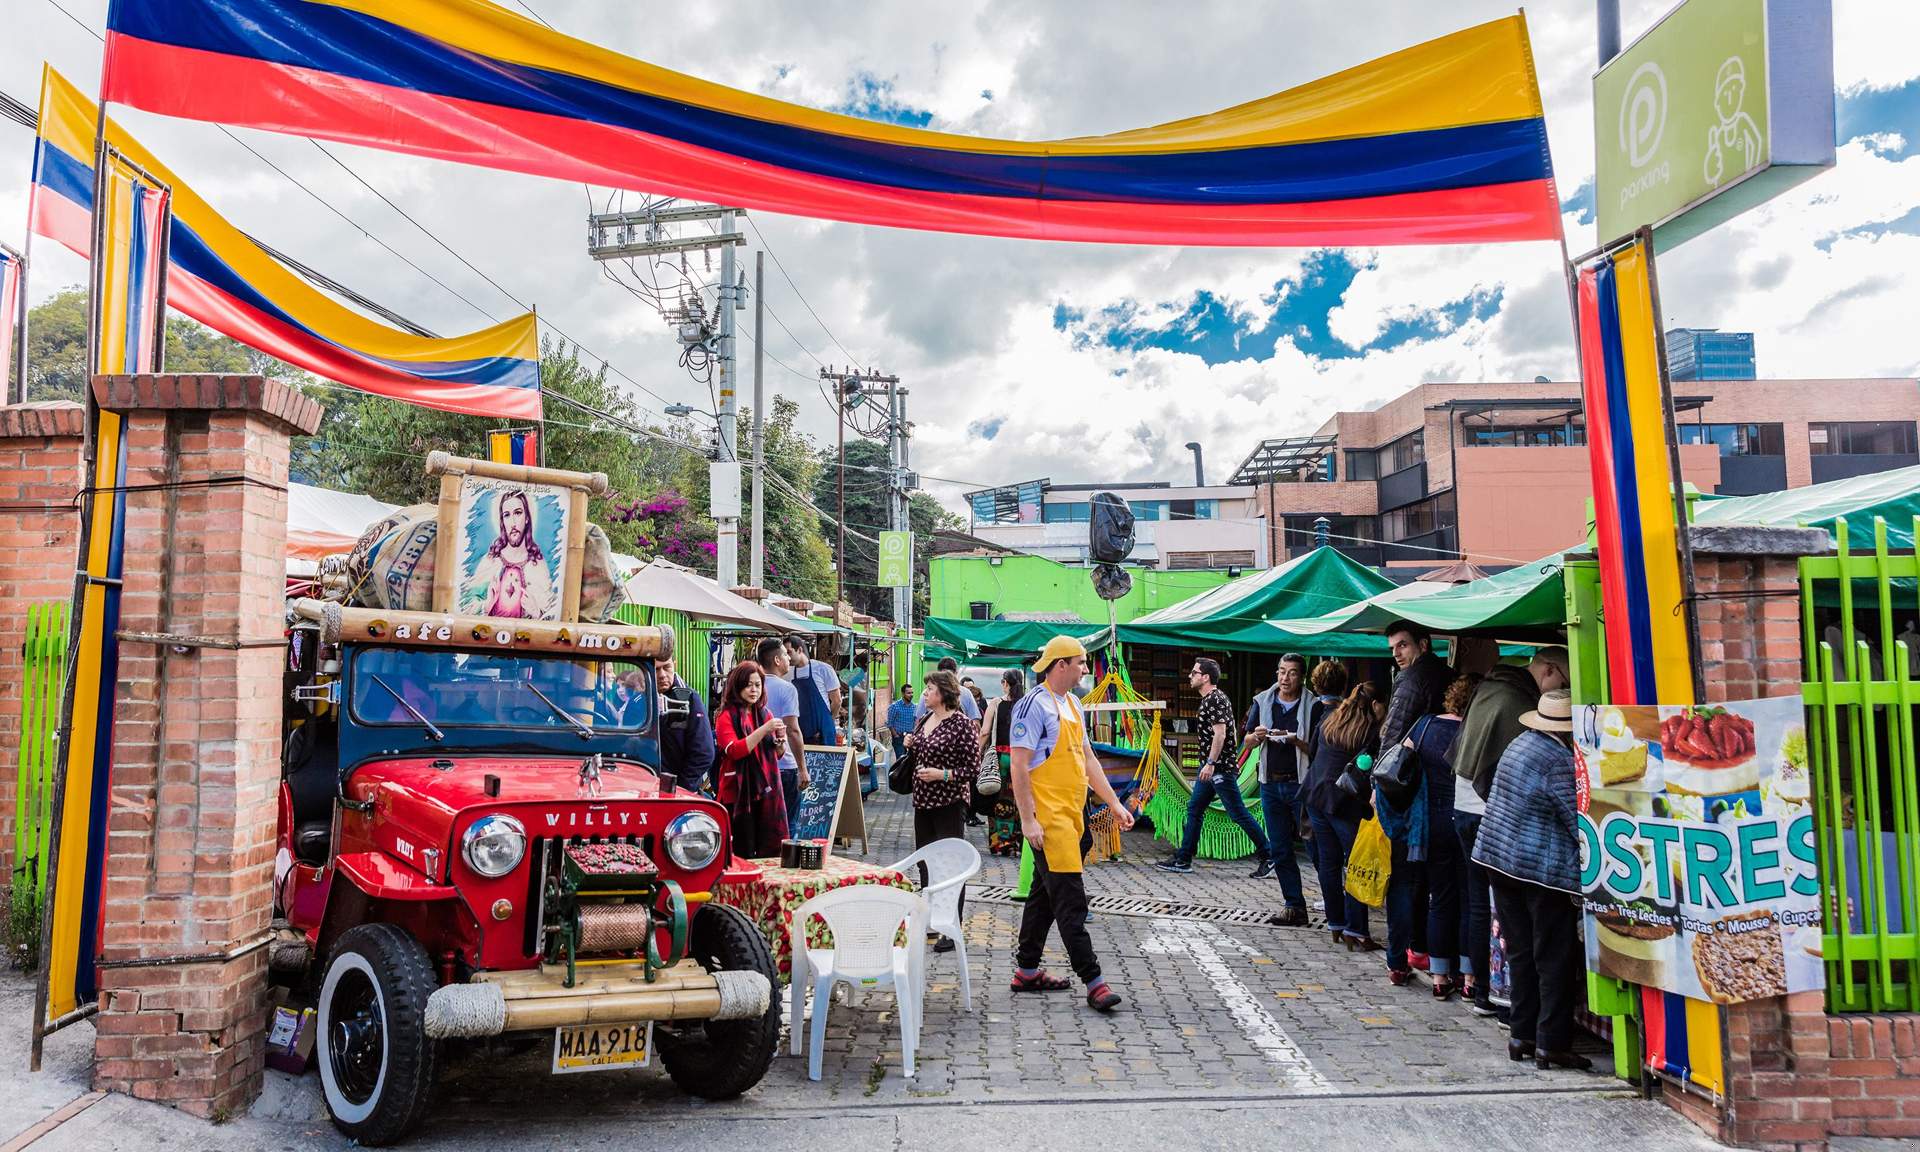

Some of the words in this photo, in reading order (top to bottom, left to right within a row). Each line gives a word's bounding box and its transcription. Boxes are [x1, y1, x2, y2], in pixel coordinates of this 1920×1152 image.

[1620, 160, 1670, 212] parking
[545, 812, 648, 826] WILLYS
[1618, 904, 1637, 919] Tres
[1638, 909, 1671, 926] Leches
[1681, 916, 1713, 934] Tortas
[1728, 917, 1770, 934] Mousse
